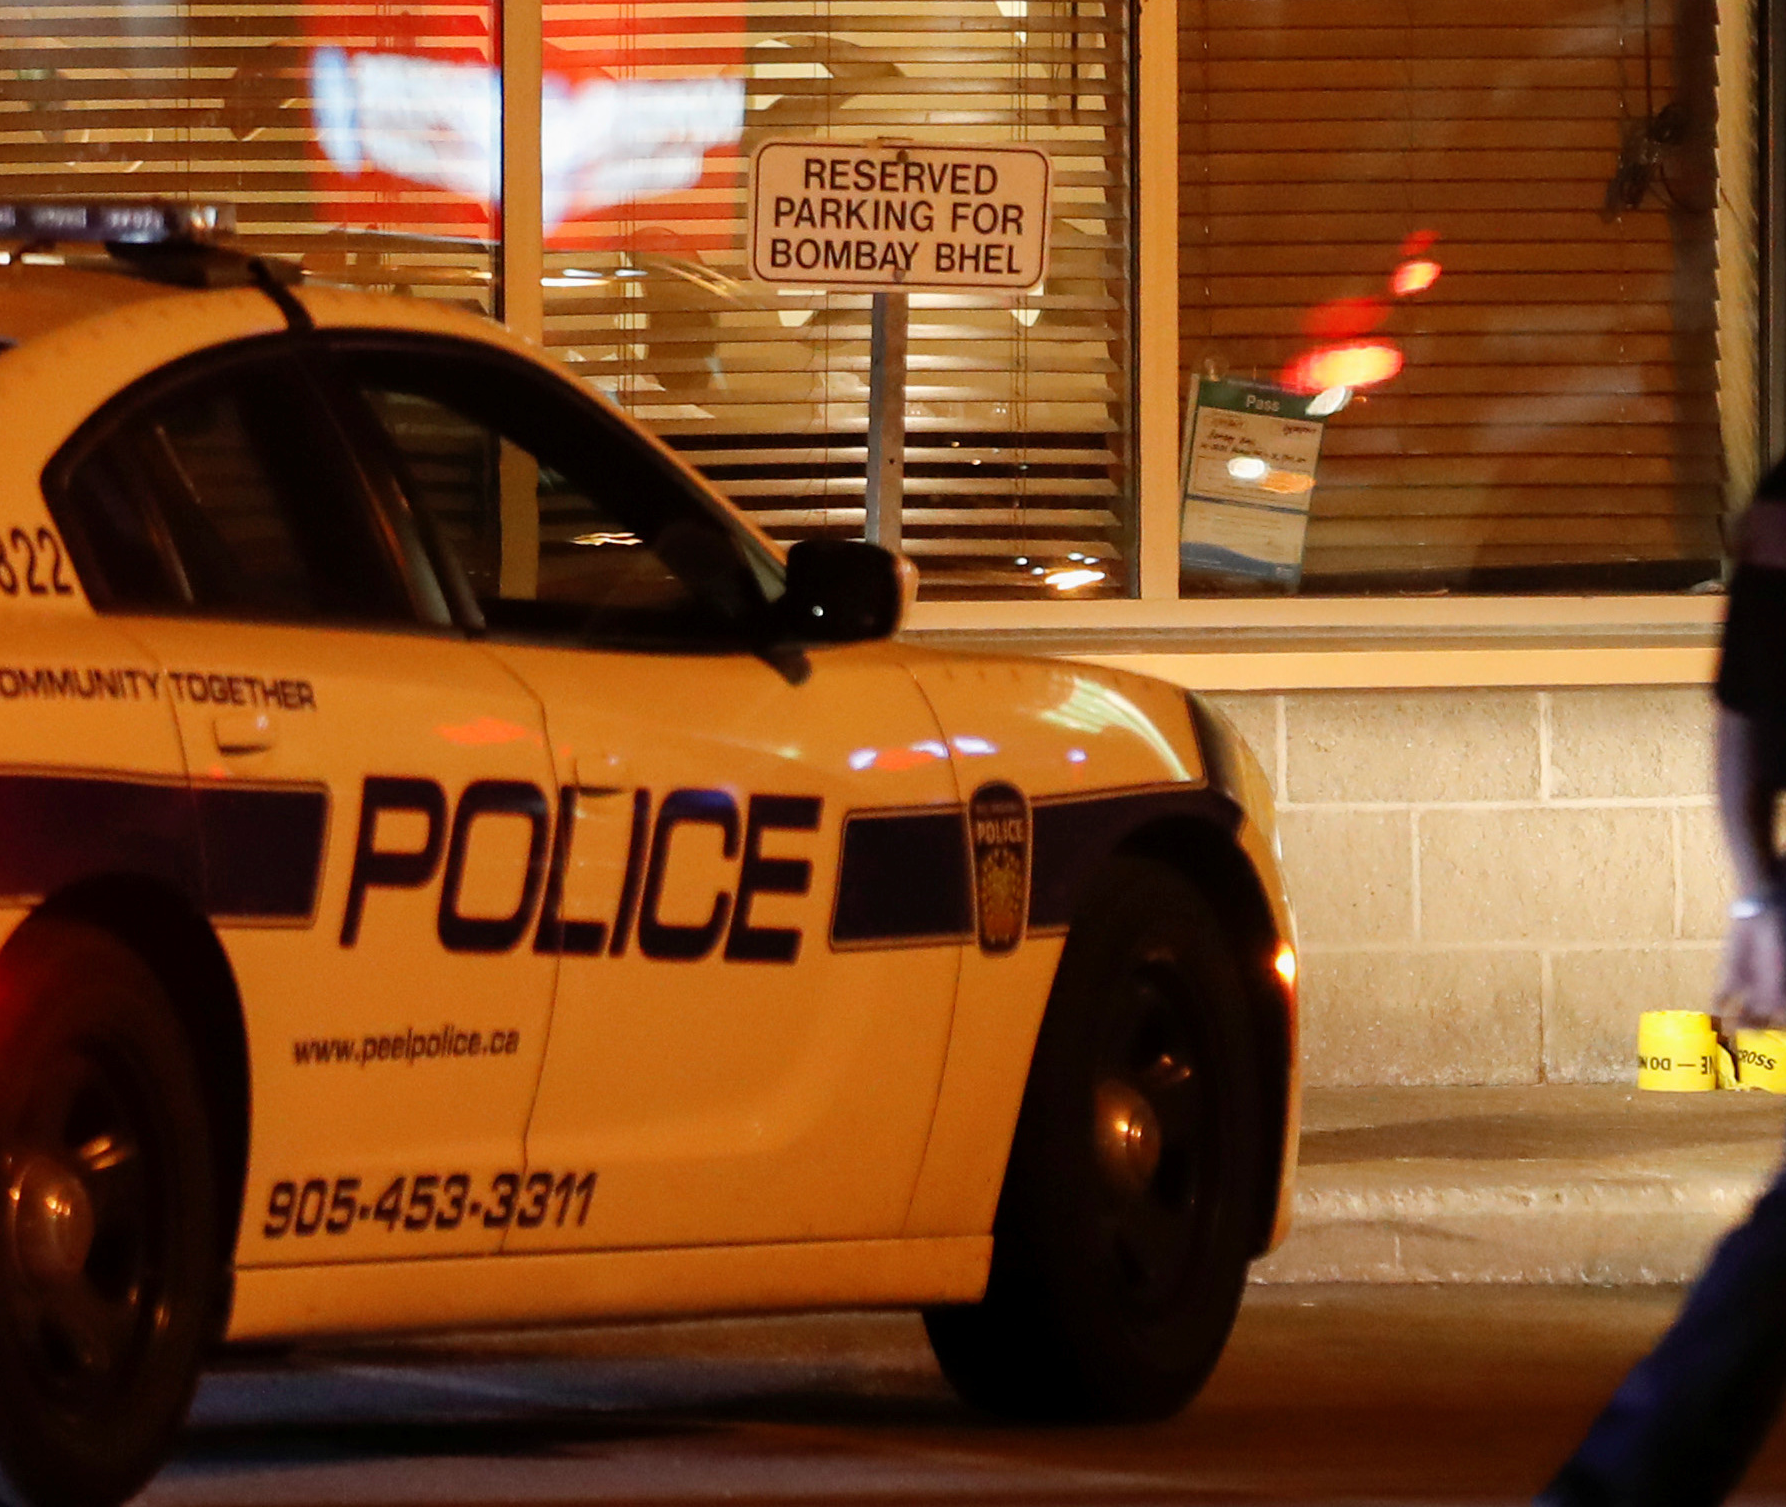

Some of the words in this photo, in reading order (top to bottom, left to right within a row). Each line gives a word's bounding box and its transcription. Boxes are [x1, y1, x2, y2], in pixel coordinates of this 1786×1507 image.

[804, 157, 998, 196] RESERVED
[774, 197, 934, 233] PARKING
[951, 202, 1024, 235] FOR
[770, 238, 919, 273] BOMBAY
[935, 243, 1022, 275] BHEL
[1246, 394, 1281, 412] Pass
[168, 671, 318, 711] TOGETHER
[977, 819, 1023, 844] POLICE
[338, 775, 825, 965] POLICE
[293, 1024, 520, 1068] www.peelpolice.ca
